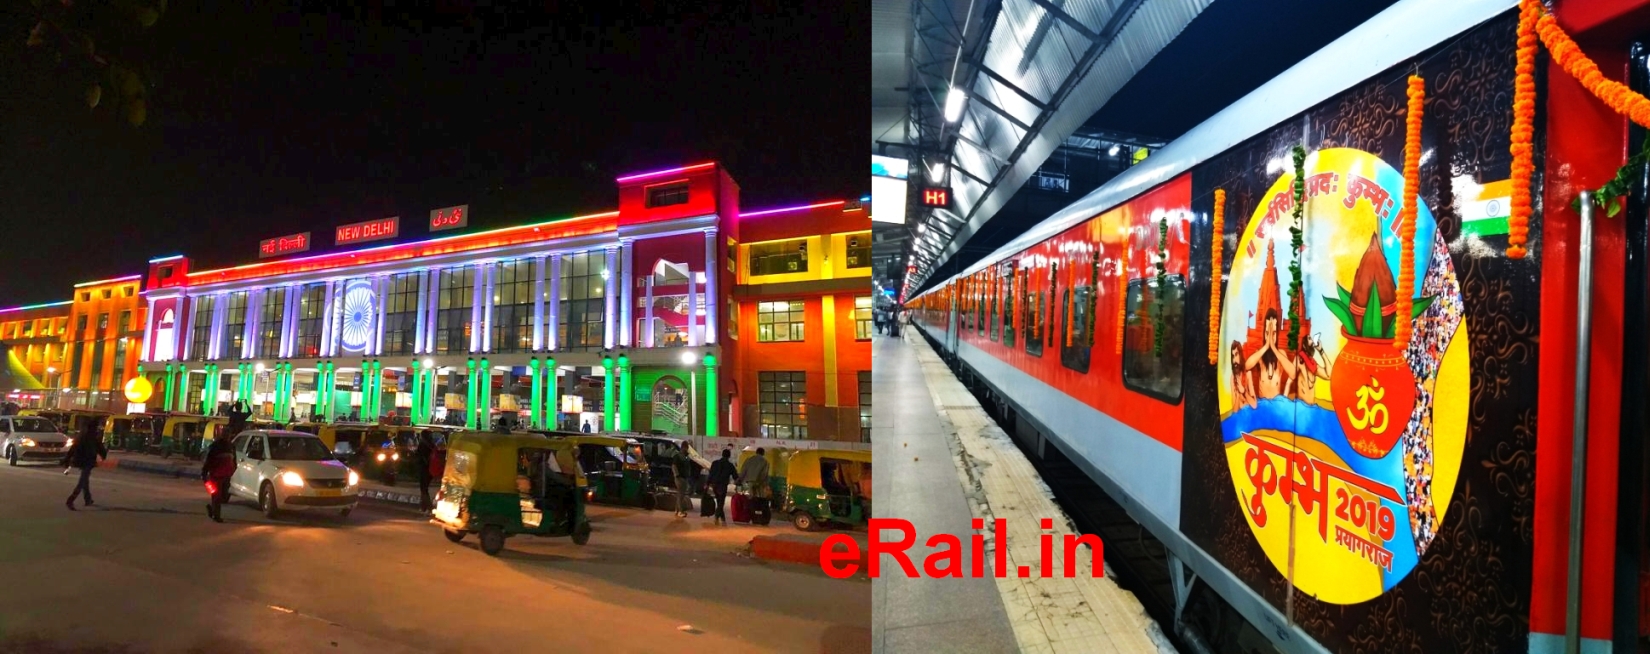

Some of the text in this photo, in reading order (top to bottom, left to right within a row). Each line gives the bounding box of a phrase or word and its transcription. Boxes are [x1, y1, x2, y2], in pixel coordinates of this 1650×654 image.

[925, 190, 946, 205] H1
[1342, 173, 1394, 219] कुम्भः
[261, 232, 306, 253] नई दिल्ली
[337, 220, 395, 241] NEW DELHI
[1240, 431, 1407, 544] कुम्भ 2019
[1334, 524, 1394, 573] प्रयागराज
